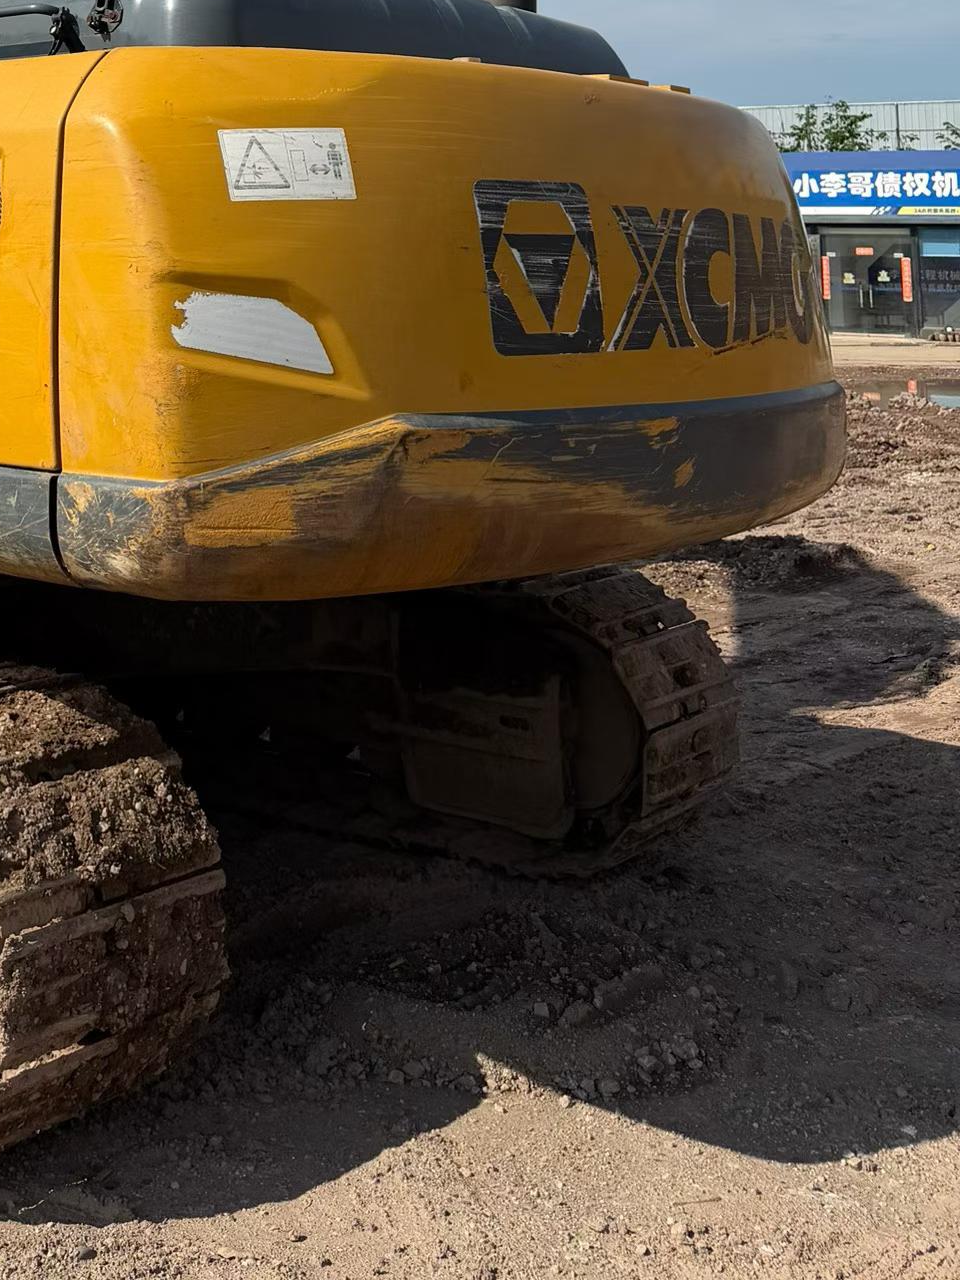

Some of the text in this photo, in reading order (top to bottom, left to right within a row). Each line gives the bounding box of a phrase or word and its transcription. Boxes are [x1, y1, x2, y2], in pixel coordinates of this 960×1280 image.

[792, 171, 960, 198] 小李哥债权机
[607, 205, 816, 350] XCMG
